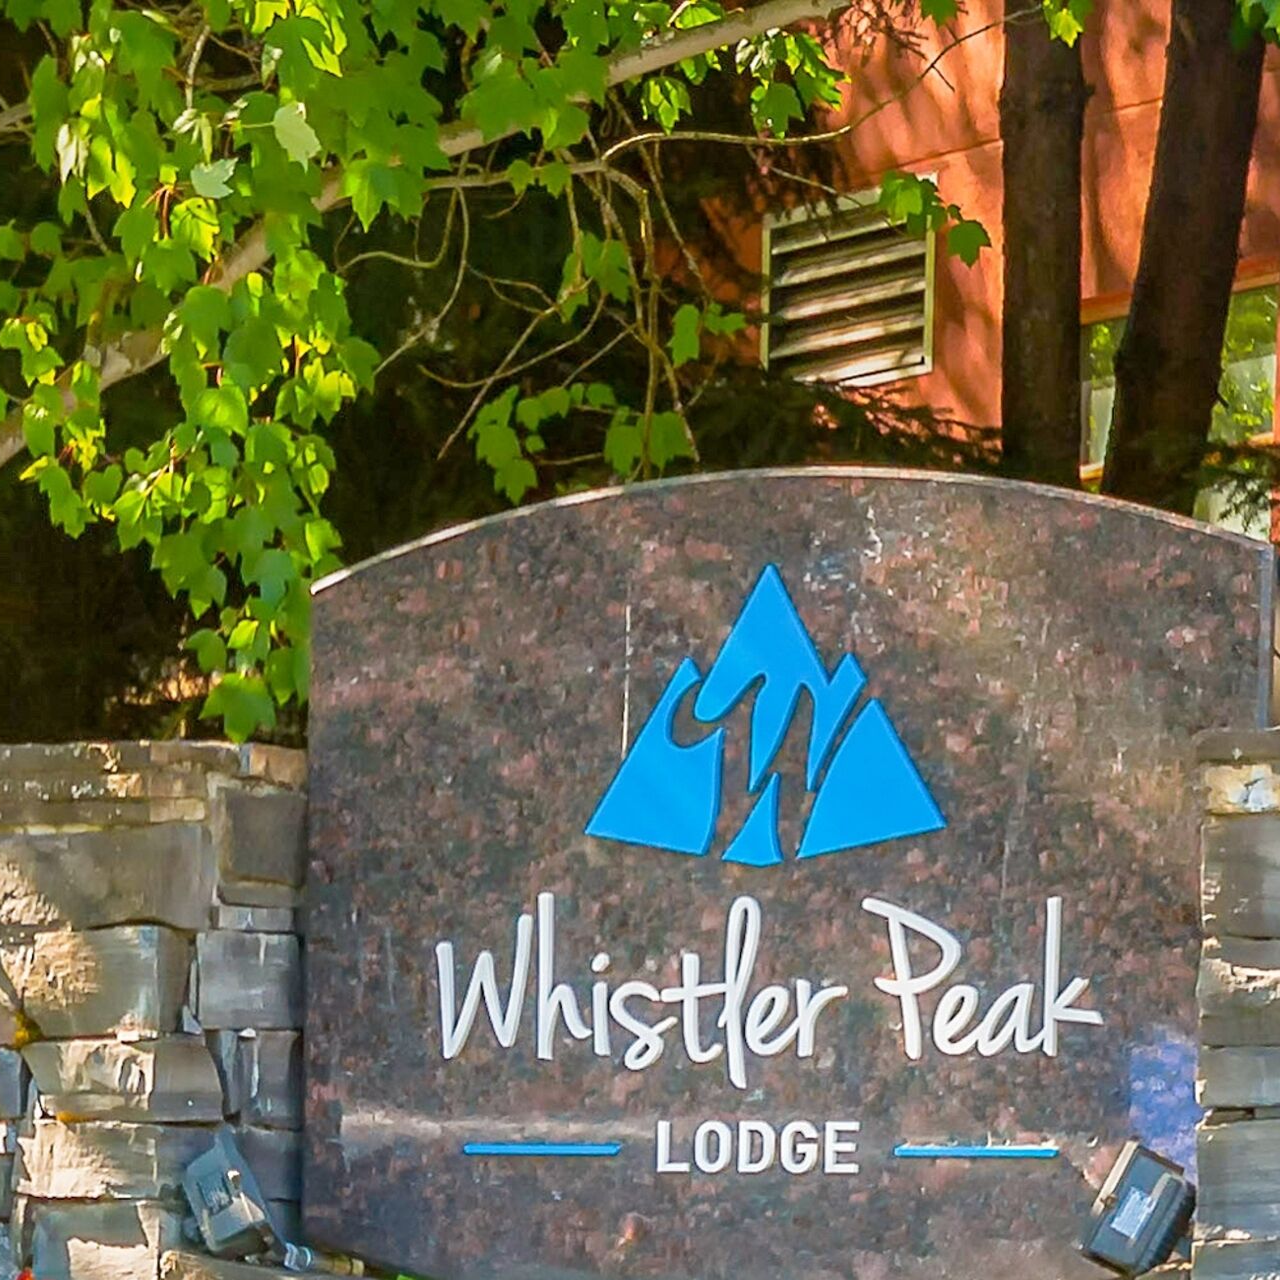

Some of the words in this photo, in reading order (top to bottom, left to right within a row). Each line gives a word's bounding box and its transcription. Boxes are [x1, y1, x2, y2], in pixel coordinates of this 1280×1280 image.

[434, 892, 849, 1089] Whistler
[861, 896, 1104, 1060] Peak
[656, 1119, 861, 1174] LODGE
